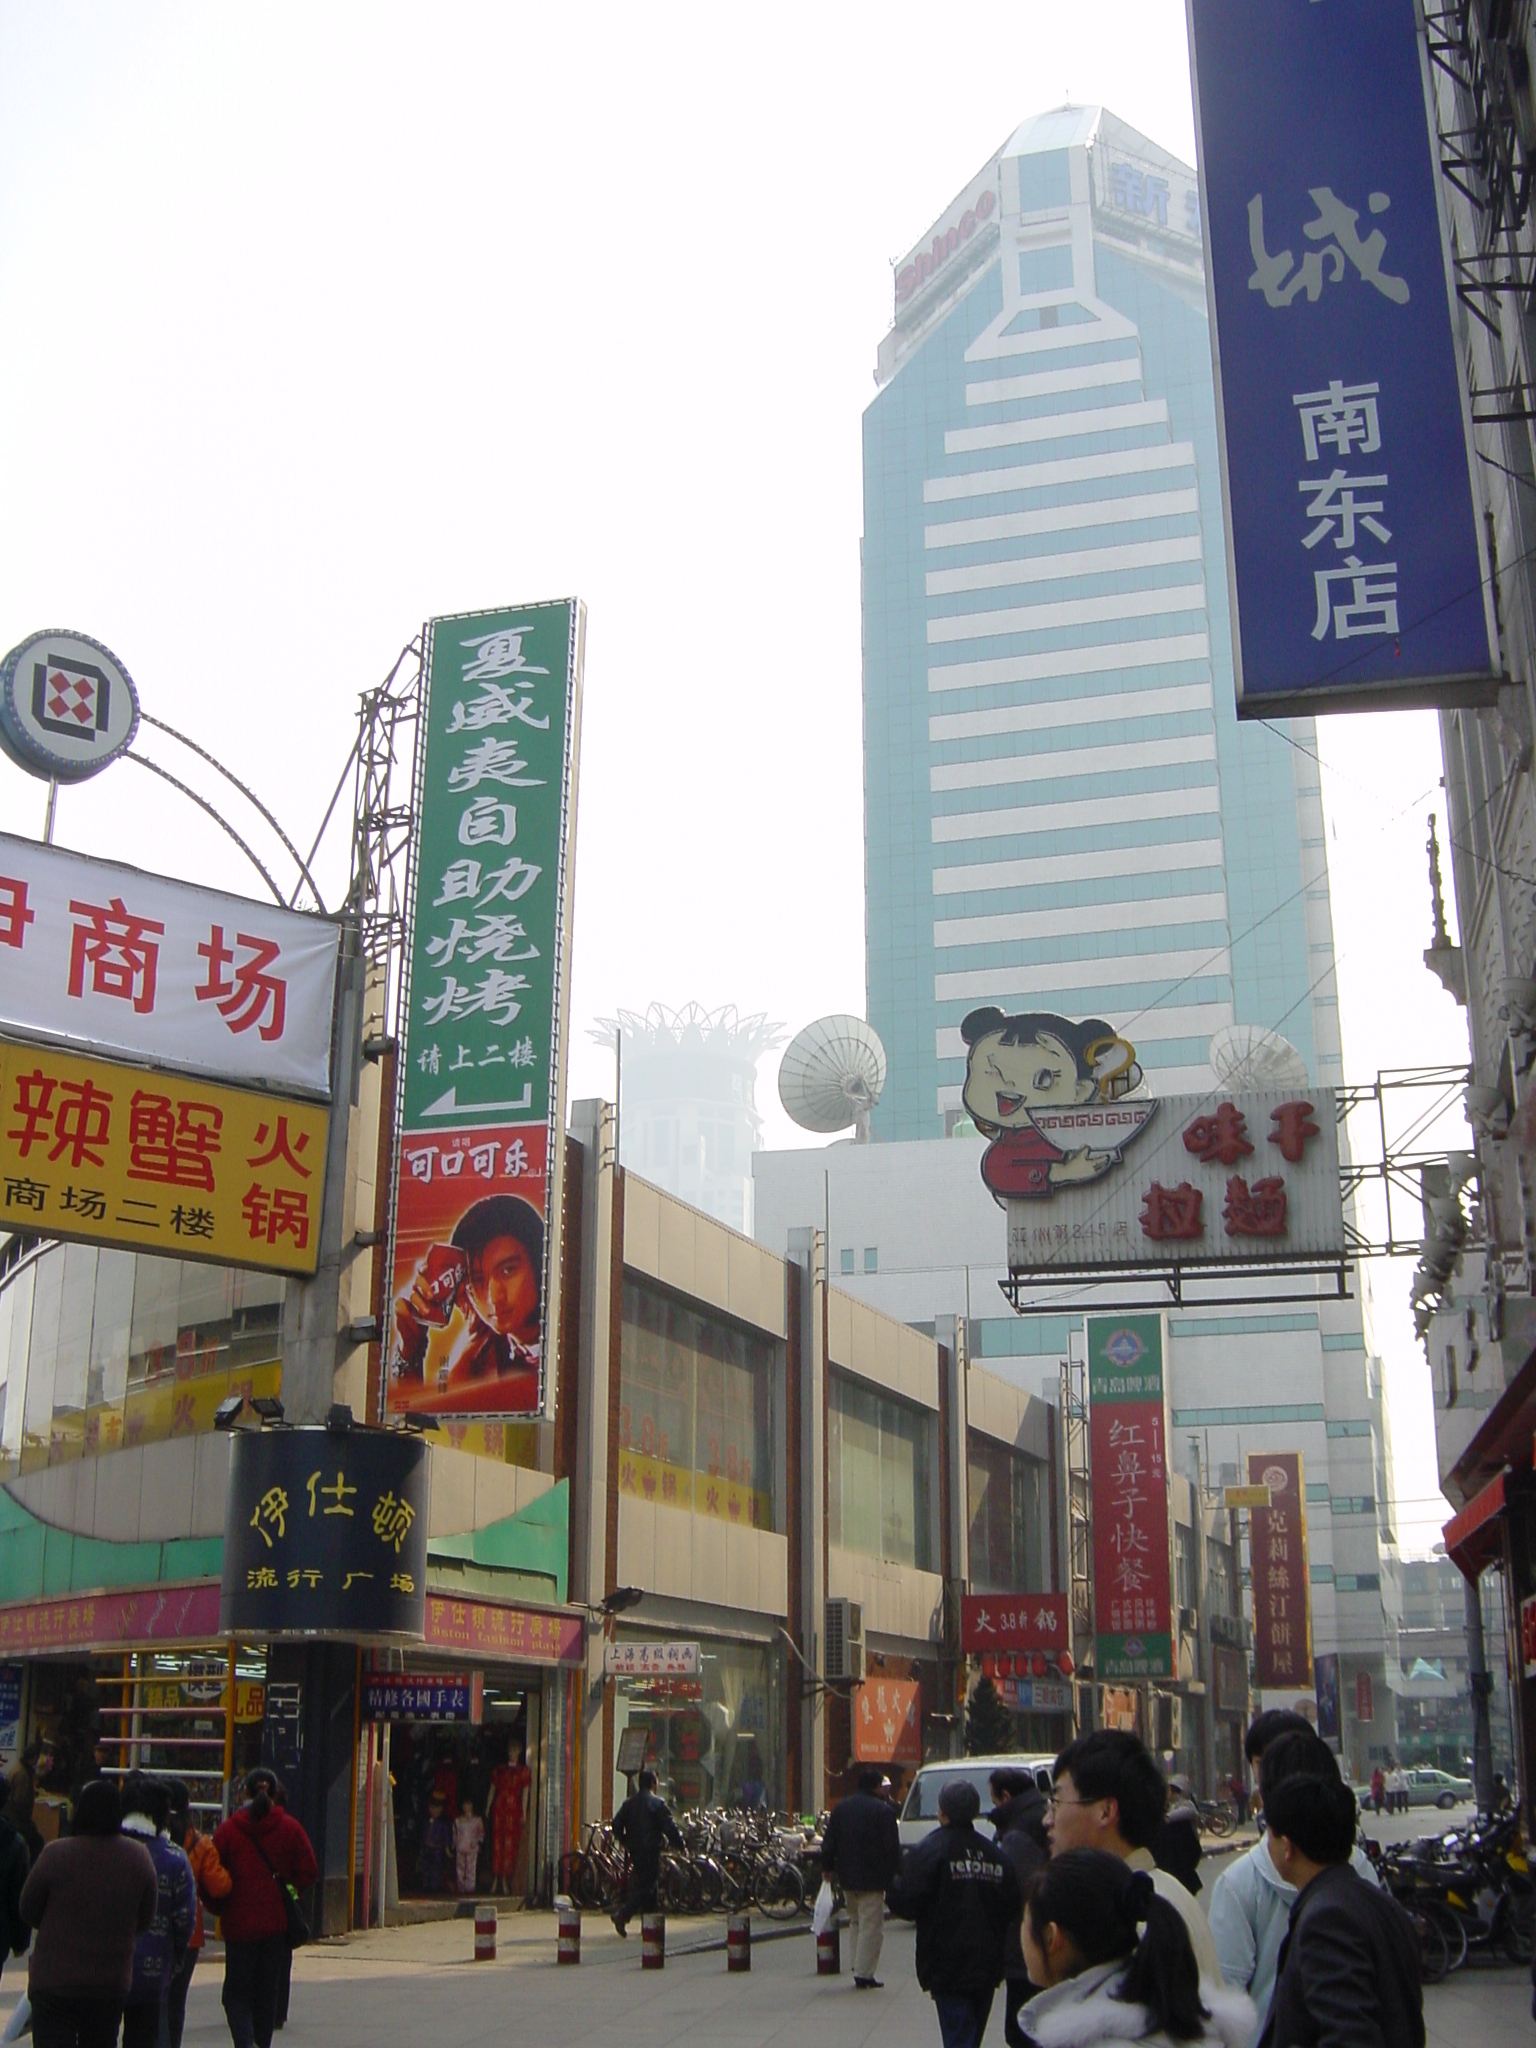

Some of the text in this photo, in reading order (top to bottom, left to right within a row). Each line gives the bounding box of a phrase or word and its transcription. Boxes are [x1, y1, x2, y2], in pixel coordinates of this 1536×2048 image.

[1292, 379, 1400, 642] 南东店
[421, 625, 550, 1027] 夏威夷自助烧烤
[416, 1035, 538, 1076] 请上二楼
[7, 1068, 232, 1193] 辣蟹
[405, 1138, 530, 1184] 可口可乐
[1182, 1101, 1321, 1166] 味千
[2, 1176, 215, 1240] 商场二楼
[241, 1115, 313, 1249] 火锅
[250, 1470, 416, 1554] 伊仕顿
[1108, 1418, 1151, 1593] 红鼻子快餐
[247, 1566, 415, 1592] 流行广场
[974, 1608, 997, 1633] 火
